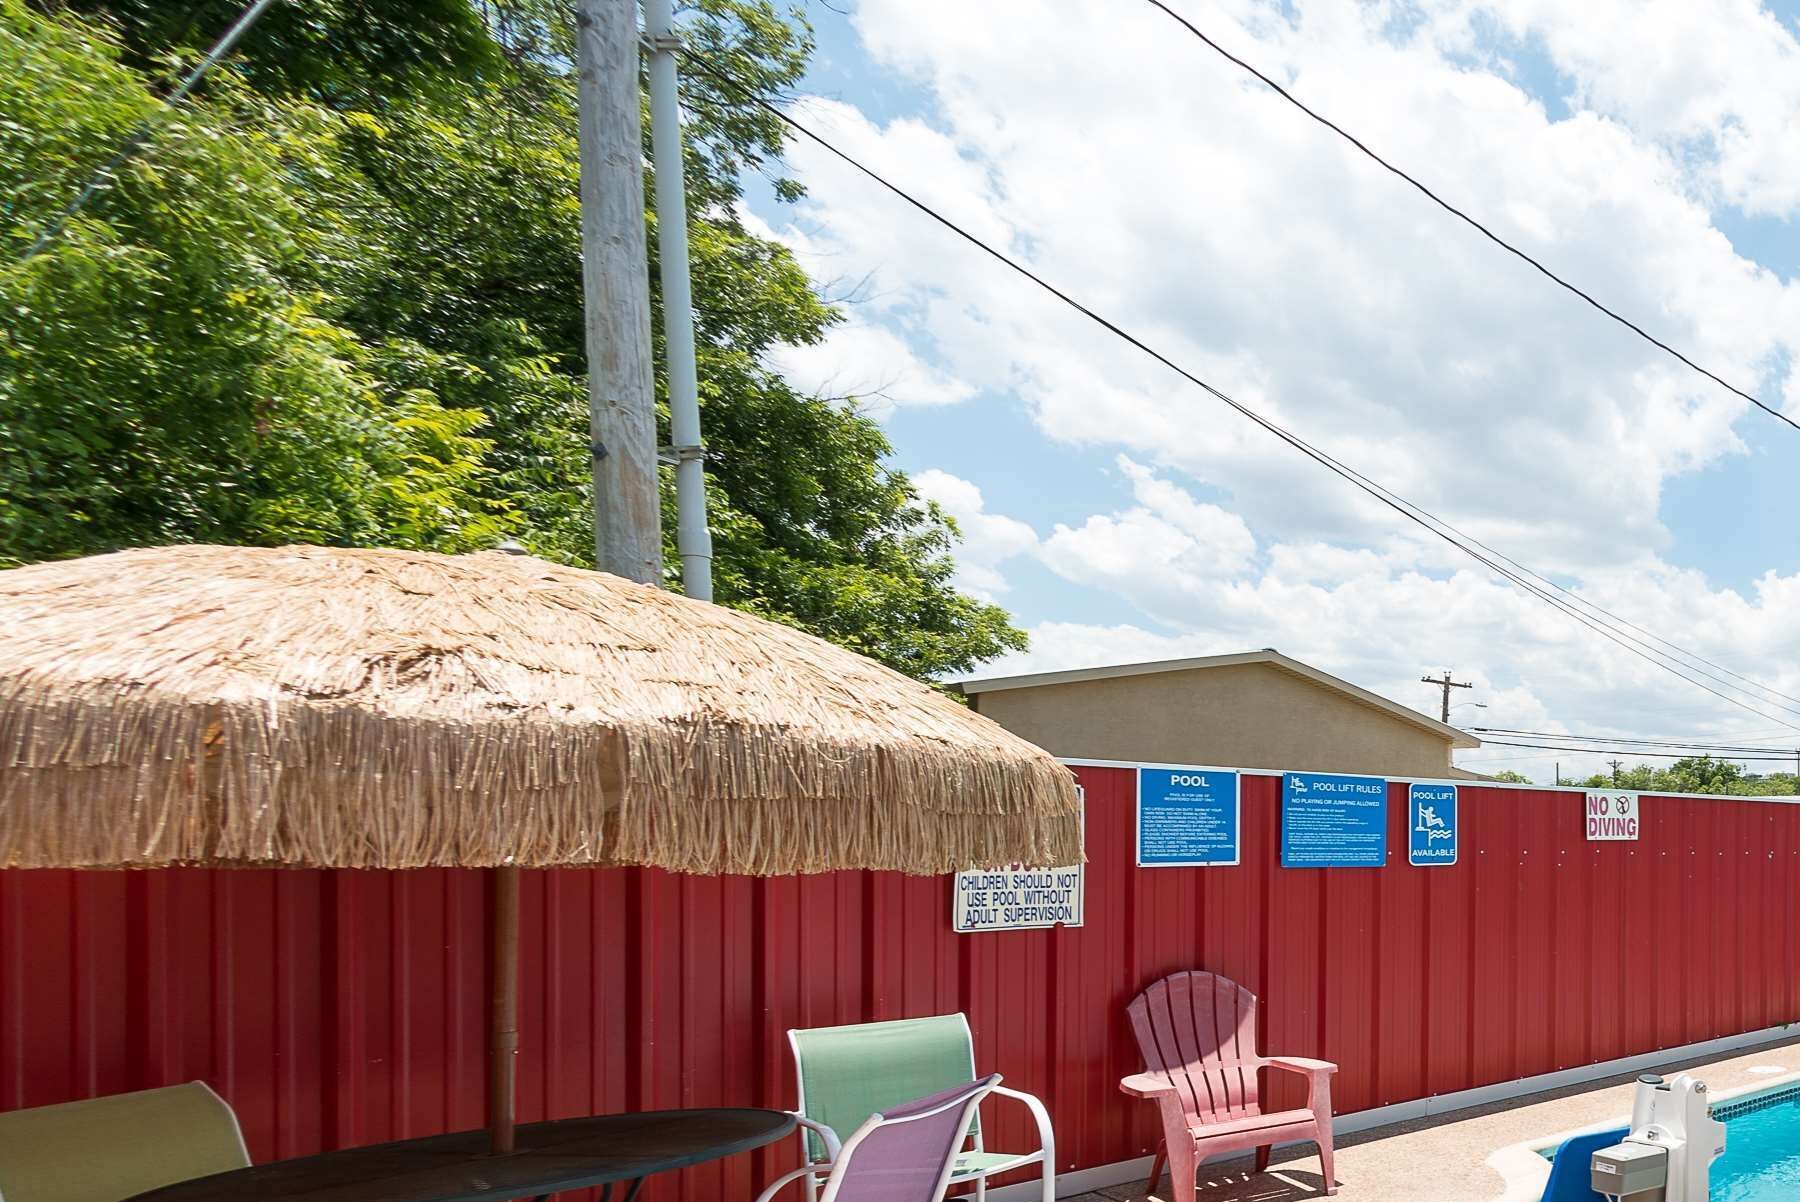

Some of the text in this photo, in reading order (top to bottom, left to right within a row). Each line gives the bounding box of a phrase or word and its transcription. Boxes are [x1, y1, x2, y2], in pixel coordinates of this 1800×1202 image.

[1171, 775, 1210, 787] POOL
[1313, 782, 1382, 794] POOL LIFT RULES
[1413, 792, 1436, 800] POOL
[1588, 796, 1608, 815] NO
[1589, 818, 1636, 836] DIVING
[961, 874, 1078, 891] CHILDREN SHOULD NOT
[967, 890, 1072, 907] USE POOL WITHOUT
[965, 906, 1072, 924] ADULT SUPERVISION
